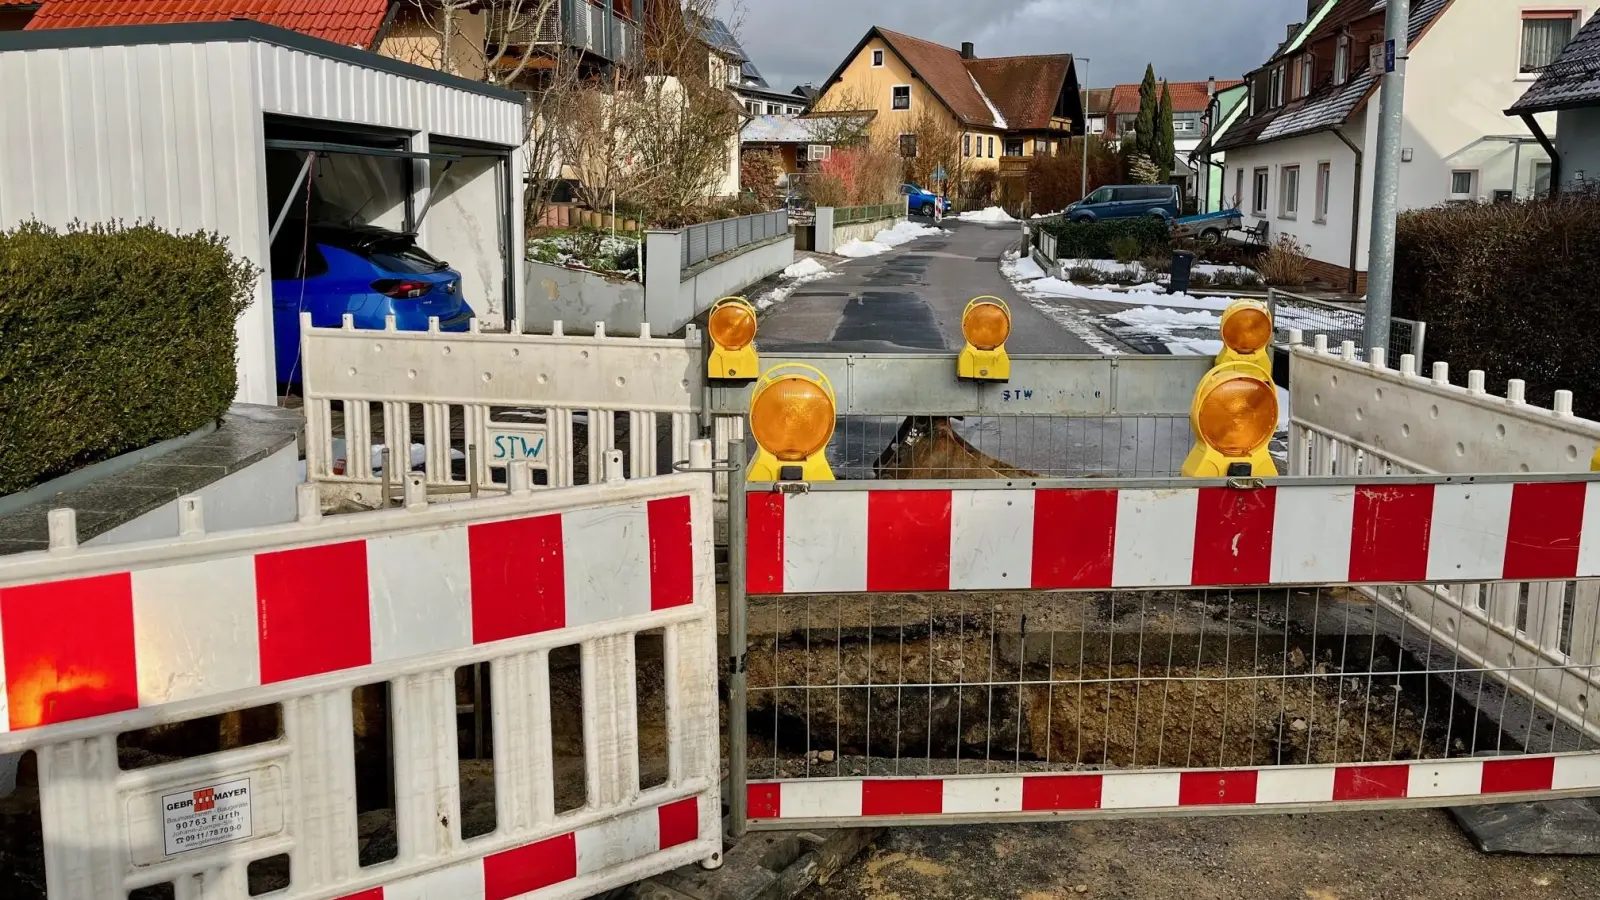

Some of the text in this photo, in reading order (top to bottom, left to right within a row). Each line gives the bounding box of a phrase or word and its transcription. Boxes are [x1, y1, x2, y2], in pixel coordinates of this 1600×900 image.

[1003, 390, 1033, 401] STW
[493, 435, 544, 459] STW
[166, 787, 247, 811] GEBR MAYER
[175, 810, 240, 830] 90763 Fürth
